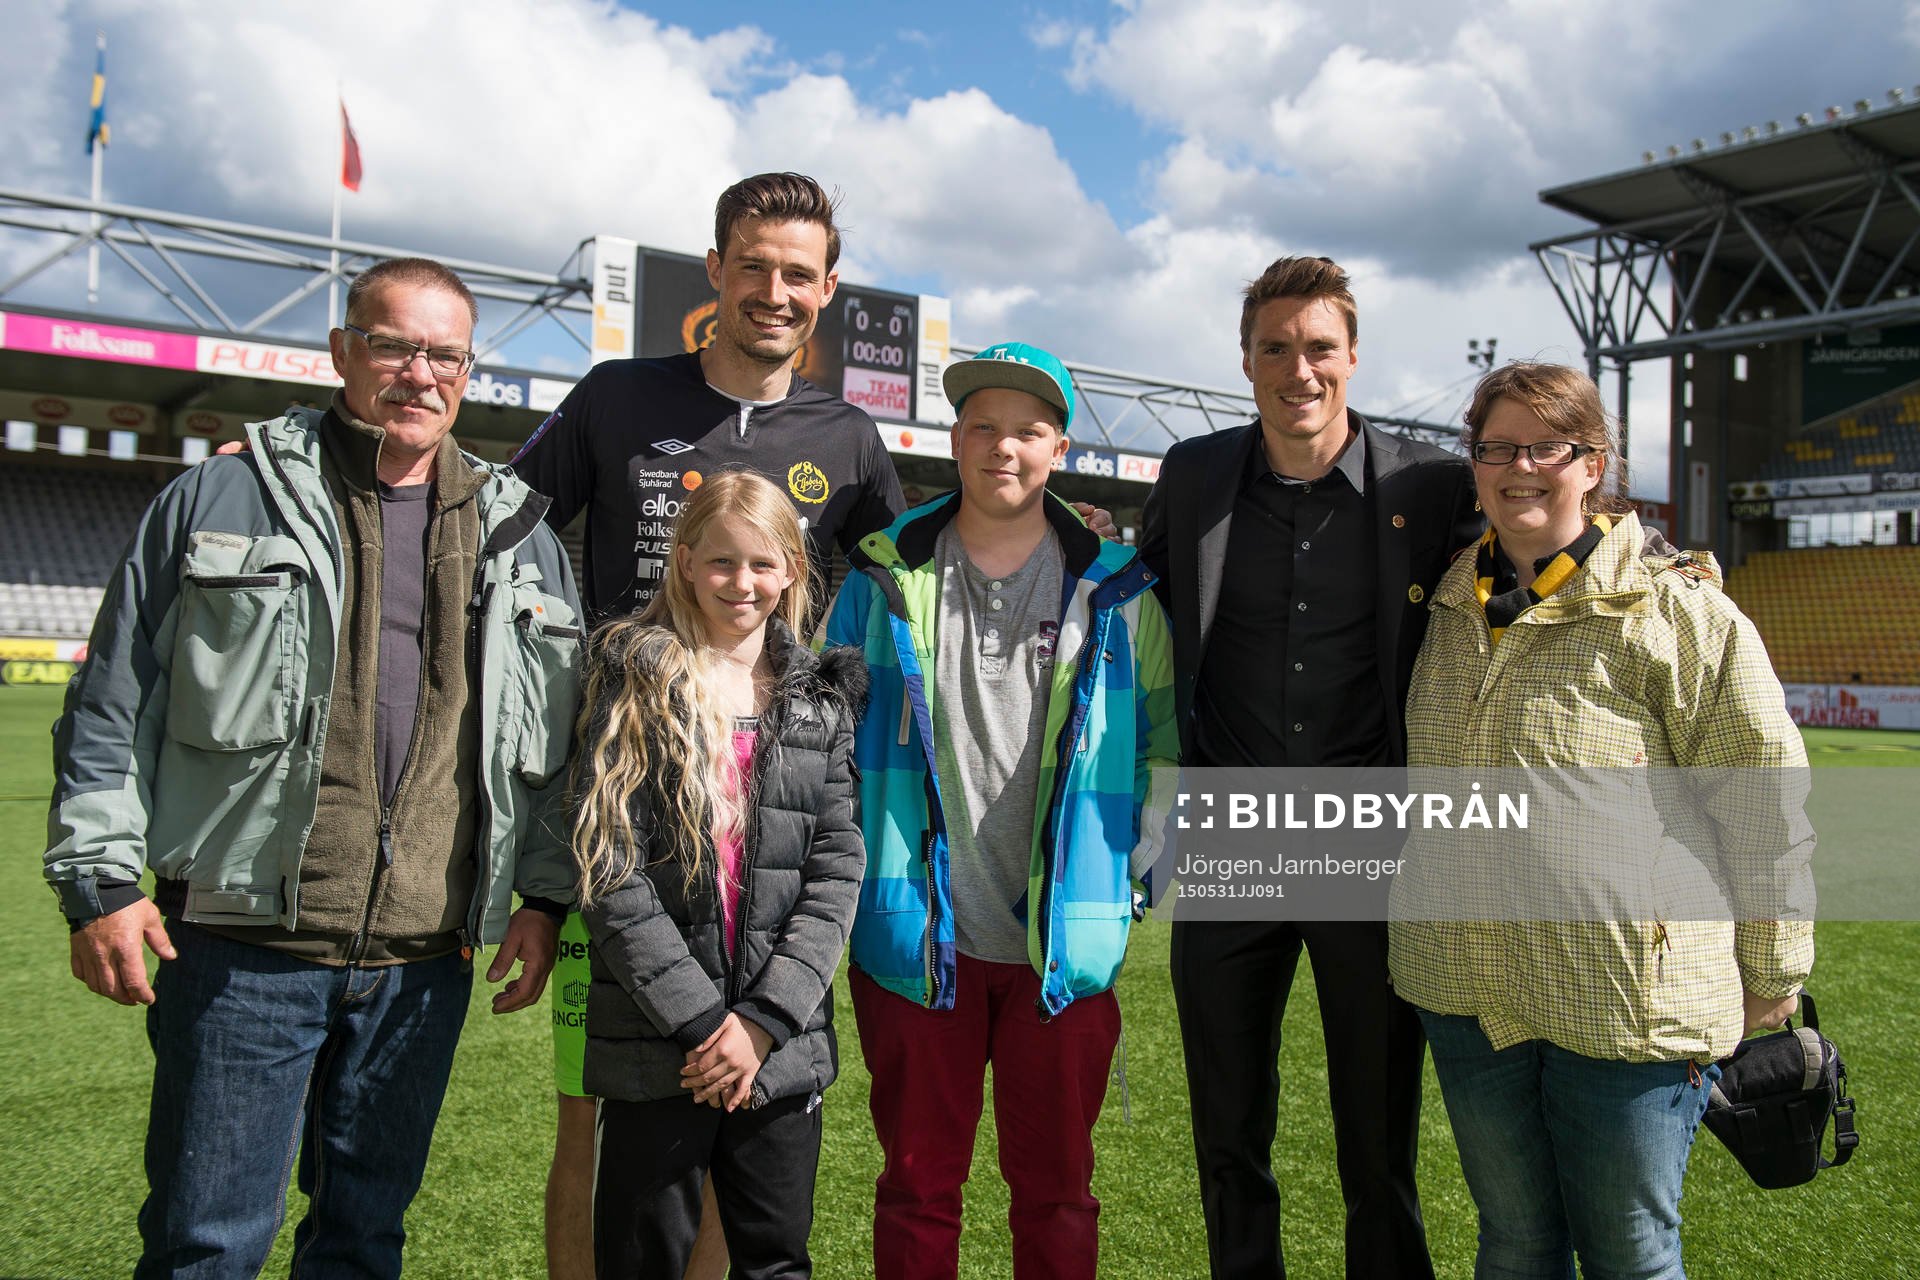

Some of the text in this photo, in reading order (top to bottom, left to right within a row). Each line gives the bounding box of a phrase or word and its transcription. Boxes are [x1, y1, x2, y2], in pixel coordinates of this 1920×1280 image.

[855, 310, 869, 331] 0
[889, 315, 903, 337] 0
[51, 324, 155, 360] Folksam
[852, 340, 904, 367] 00:00
[868, 379, 907, 397] TEAM
[846, 390, 907, 411] SPORTIA
[1075, 450, 1115, 477] ellos
[638, 479, 673, 488] Sjuhärad
[640, 469, 679, 479] Swedbank
[637, 521, 677, 538] Folks
[634, 541, 673, 554] PULS
